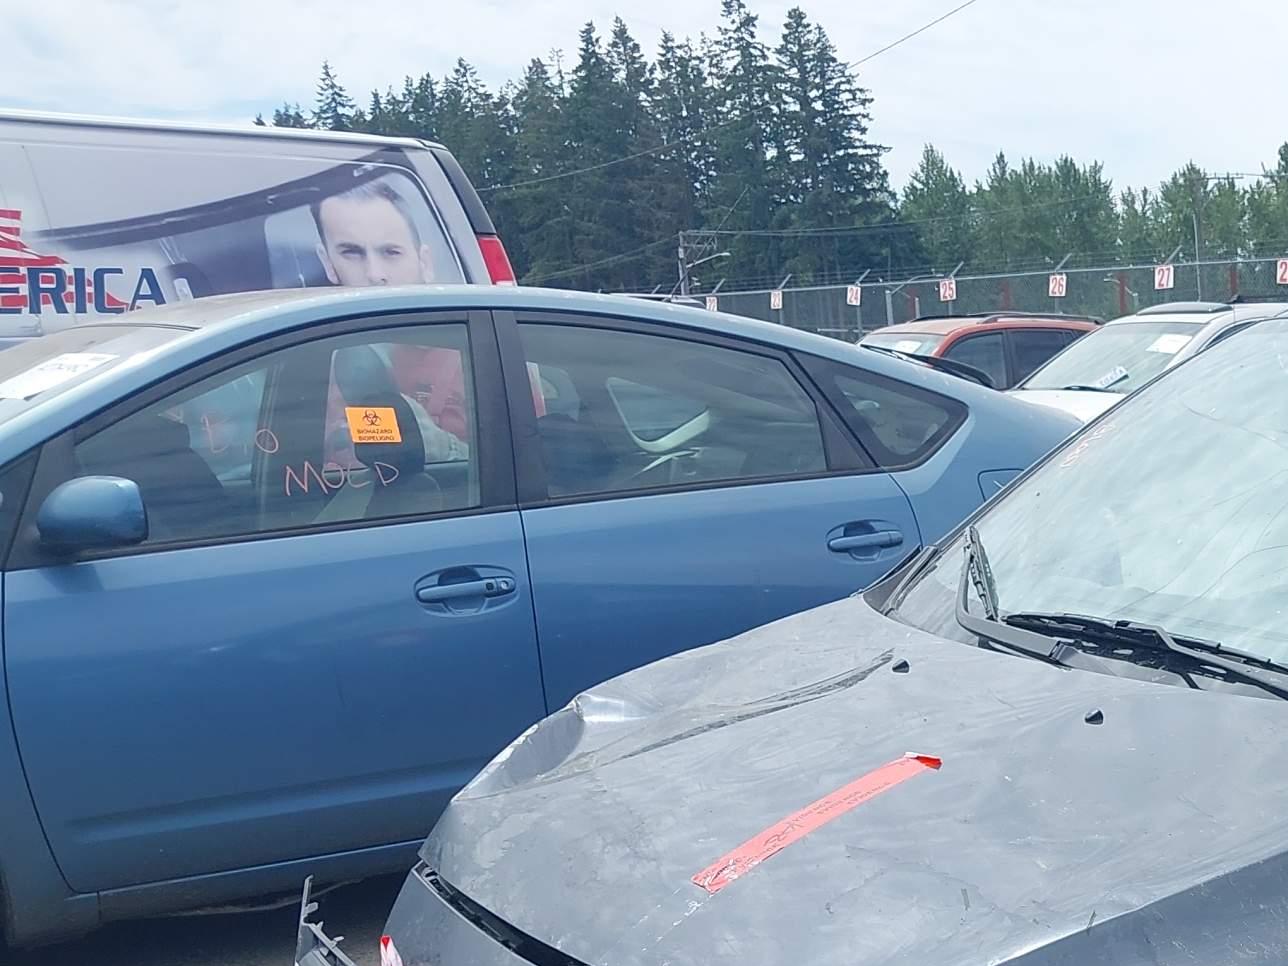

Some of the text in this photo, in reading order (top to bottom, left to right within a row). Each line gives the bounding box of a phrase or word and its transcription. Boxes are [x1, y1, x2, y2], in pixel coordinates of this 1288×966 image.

[1051, 277, 1064, 295] 26
[1157, 267, 1171, 288] 27
[849, 287, 859, 304] 24
[942, 282, 954, 299] 25
